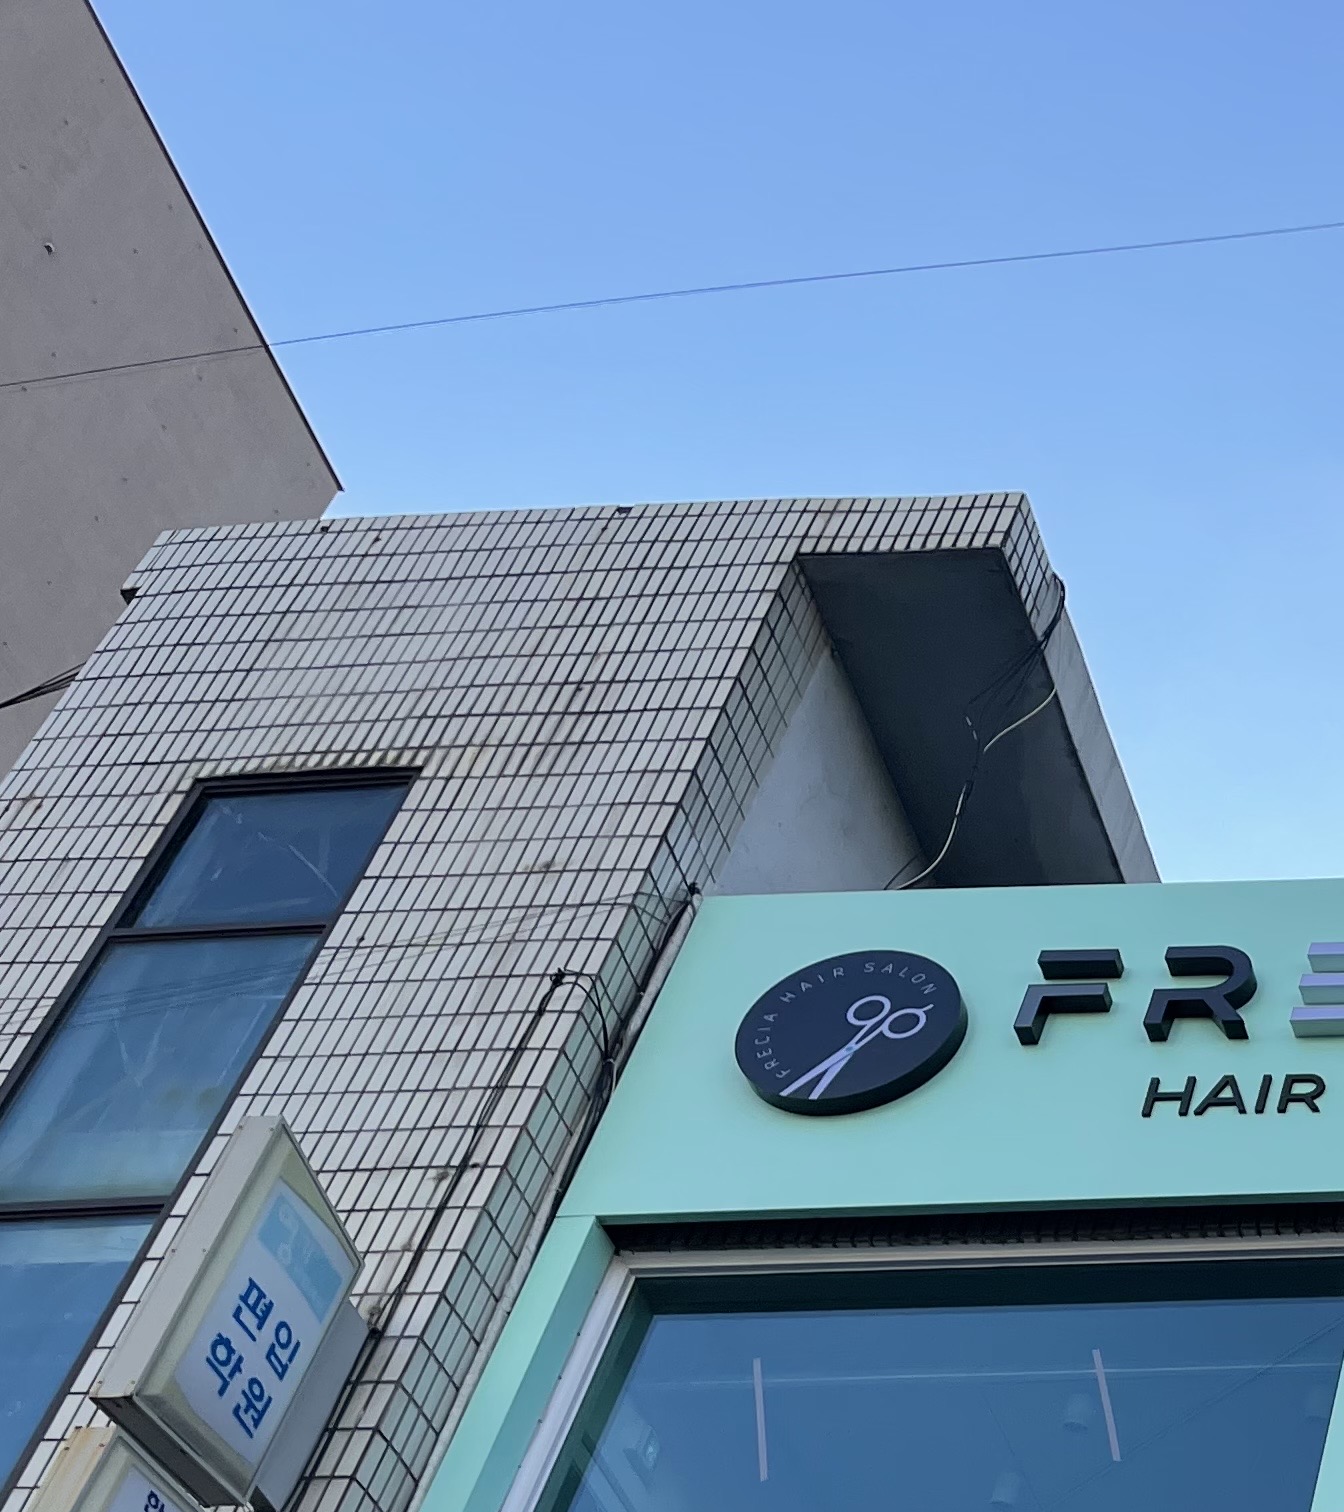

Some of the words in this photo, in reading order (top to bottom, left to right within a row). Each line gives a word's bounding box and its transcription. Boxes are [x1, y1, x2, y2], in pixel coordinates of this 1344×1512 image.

[754, 1011, 791, 1079] FRECIA
[779, 967, 845, 1003] HAIR
[863, 962, 938, 995] SALON
[1141, 1073, 1327, 1120] HAIR
[232, 1277, 300, 1382] 편입
[206, 1332, 273, 1439] 학원
